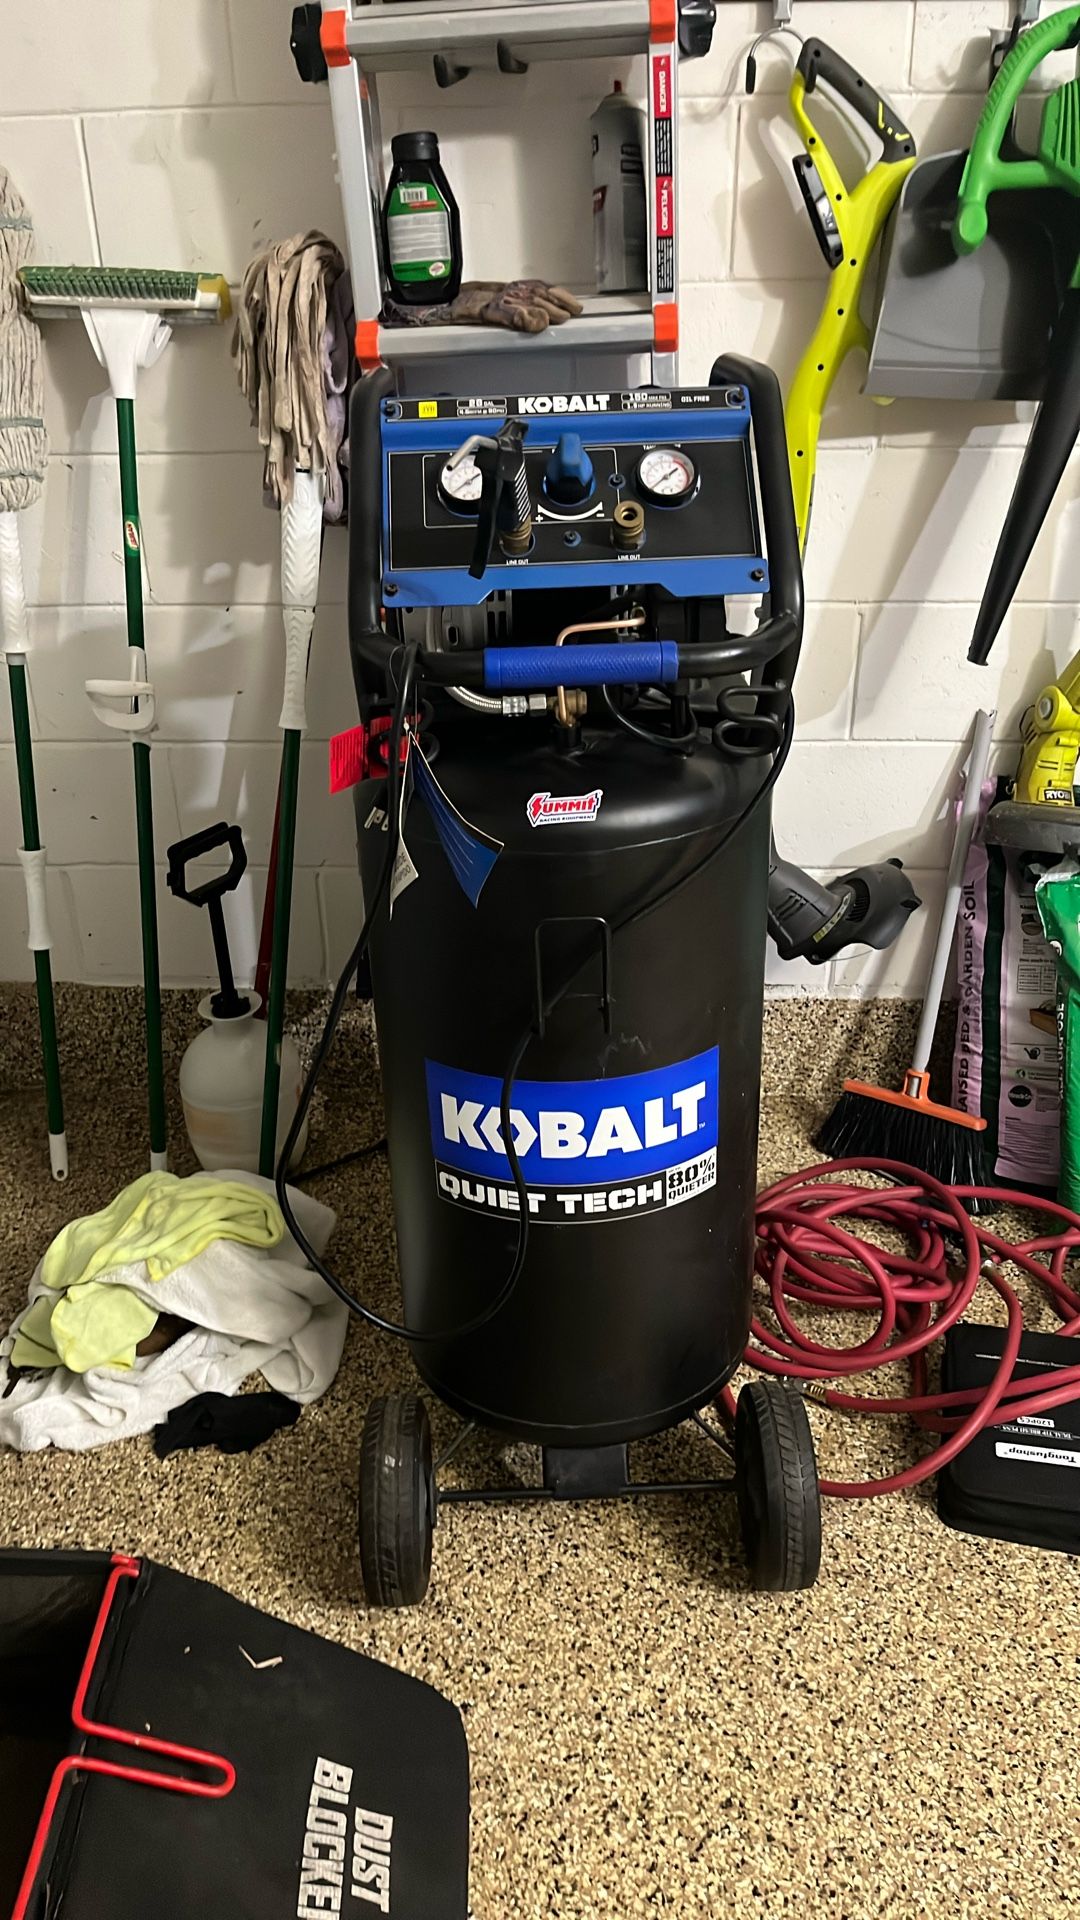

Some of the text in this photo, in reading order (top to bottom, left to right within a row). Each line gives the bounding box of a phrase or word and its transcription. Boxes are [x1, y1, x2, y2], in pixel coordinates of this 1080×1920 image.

[659, 71, 667, 112] DANGER
[661, 190, 669, 231] PELIGRO
[518, 394, 610, 414] KOBALT
[963, 880, 976, 921] SOIL
[962, 1004, 970, 1016] &
[440, 1081, 706, 1159] KOBALT
[668, 1154, 715, 1189] 80%
[668, 1171, 715, 1200] QUIETER
[439, 1171, 663, 1215] QUIET TECH
[1008, 1447, 1077, 1464] Tongfushop
[351, 1806, 393, 1913] DUST
